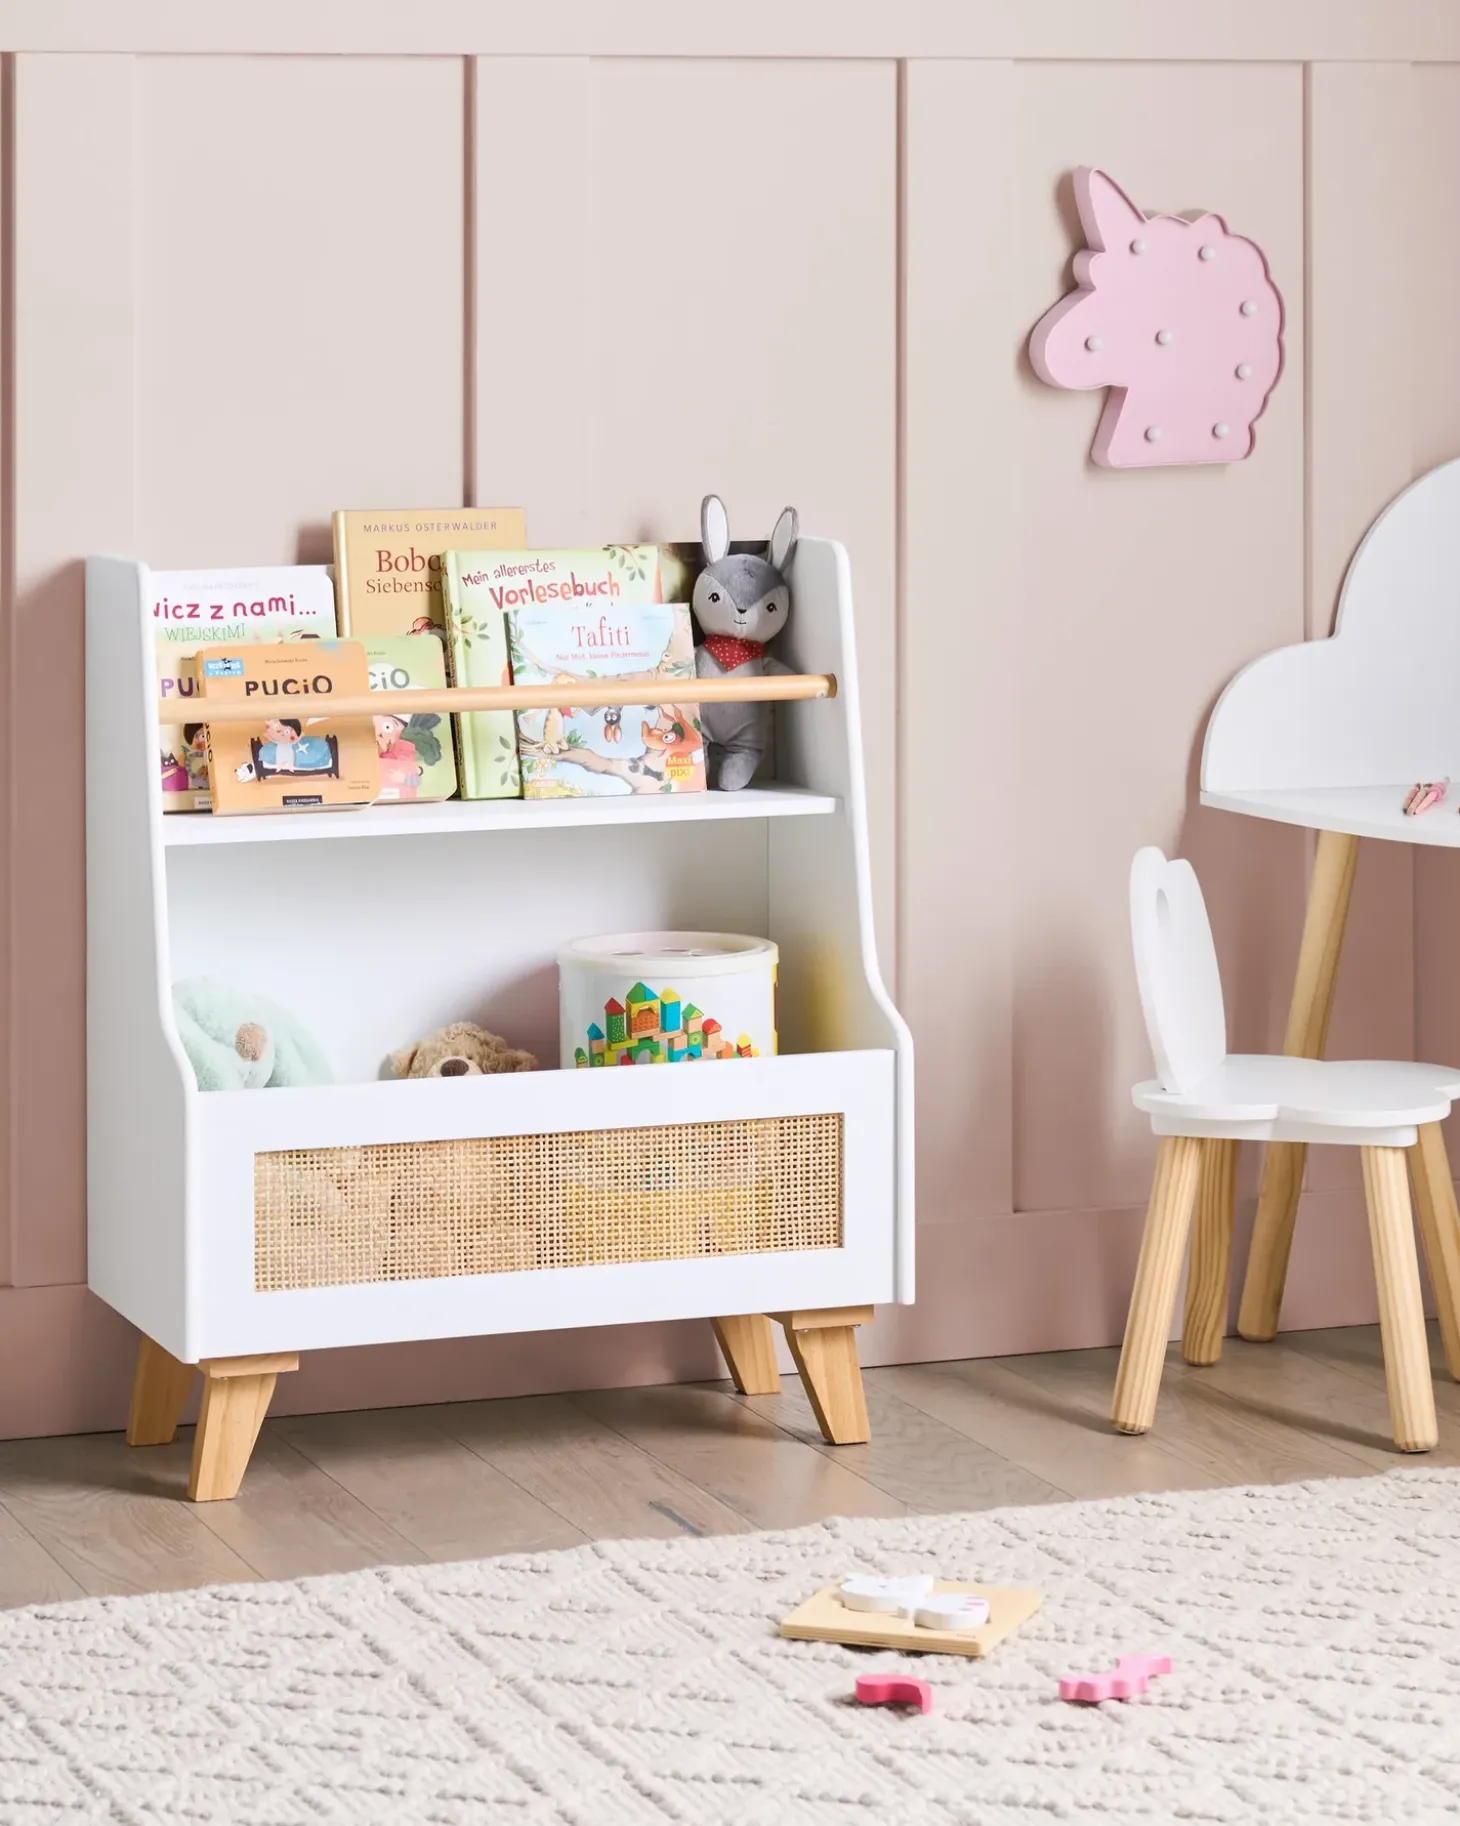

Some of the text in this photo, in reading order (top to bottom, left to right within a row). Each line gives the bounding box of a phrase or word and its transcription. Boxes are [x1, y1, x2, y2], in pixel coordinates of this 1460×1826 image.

[363, 521, 498, 533] MARKUS OSTERWALDER
[461, 558, 556, 588] Mein allererstes
[488, 570, 620, 610] Vorlesebuch
[209, 604, 225, 620] z
[232, 593, 317, 618] nami...
[164, 622, 246, 643] WIEJSKIMI
[571, 615, 631, 649] Tafiti
[160, 677, 201, 698] PU
[667, 755, 691, 765] Maxi
[670, 767, 691, 778] pixi
